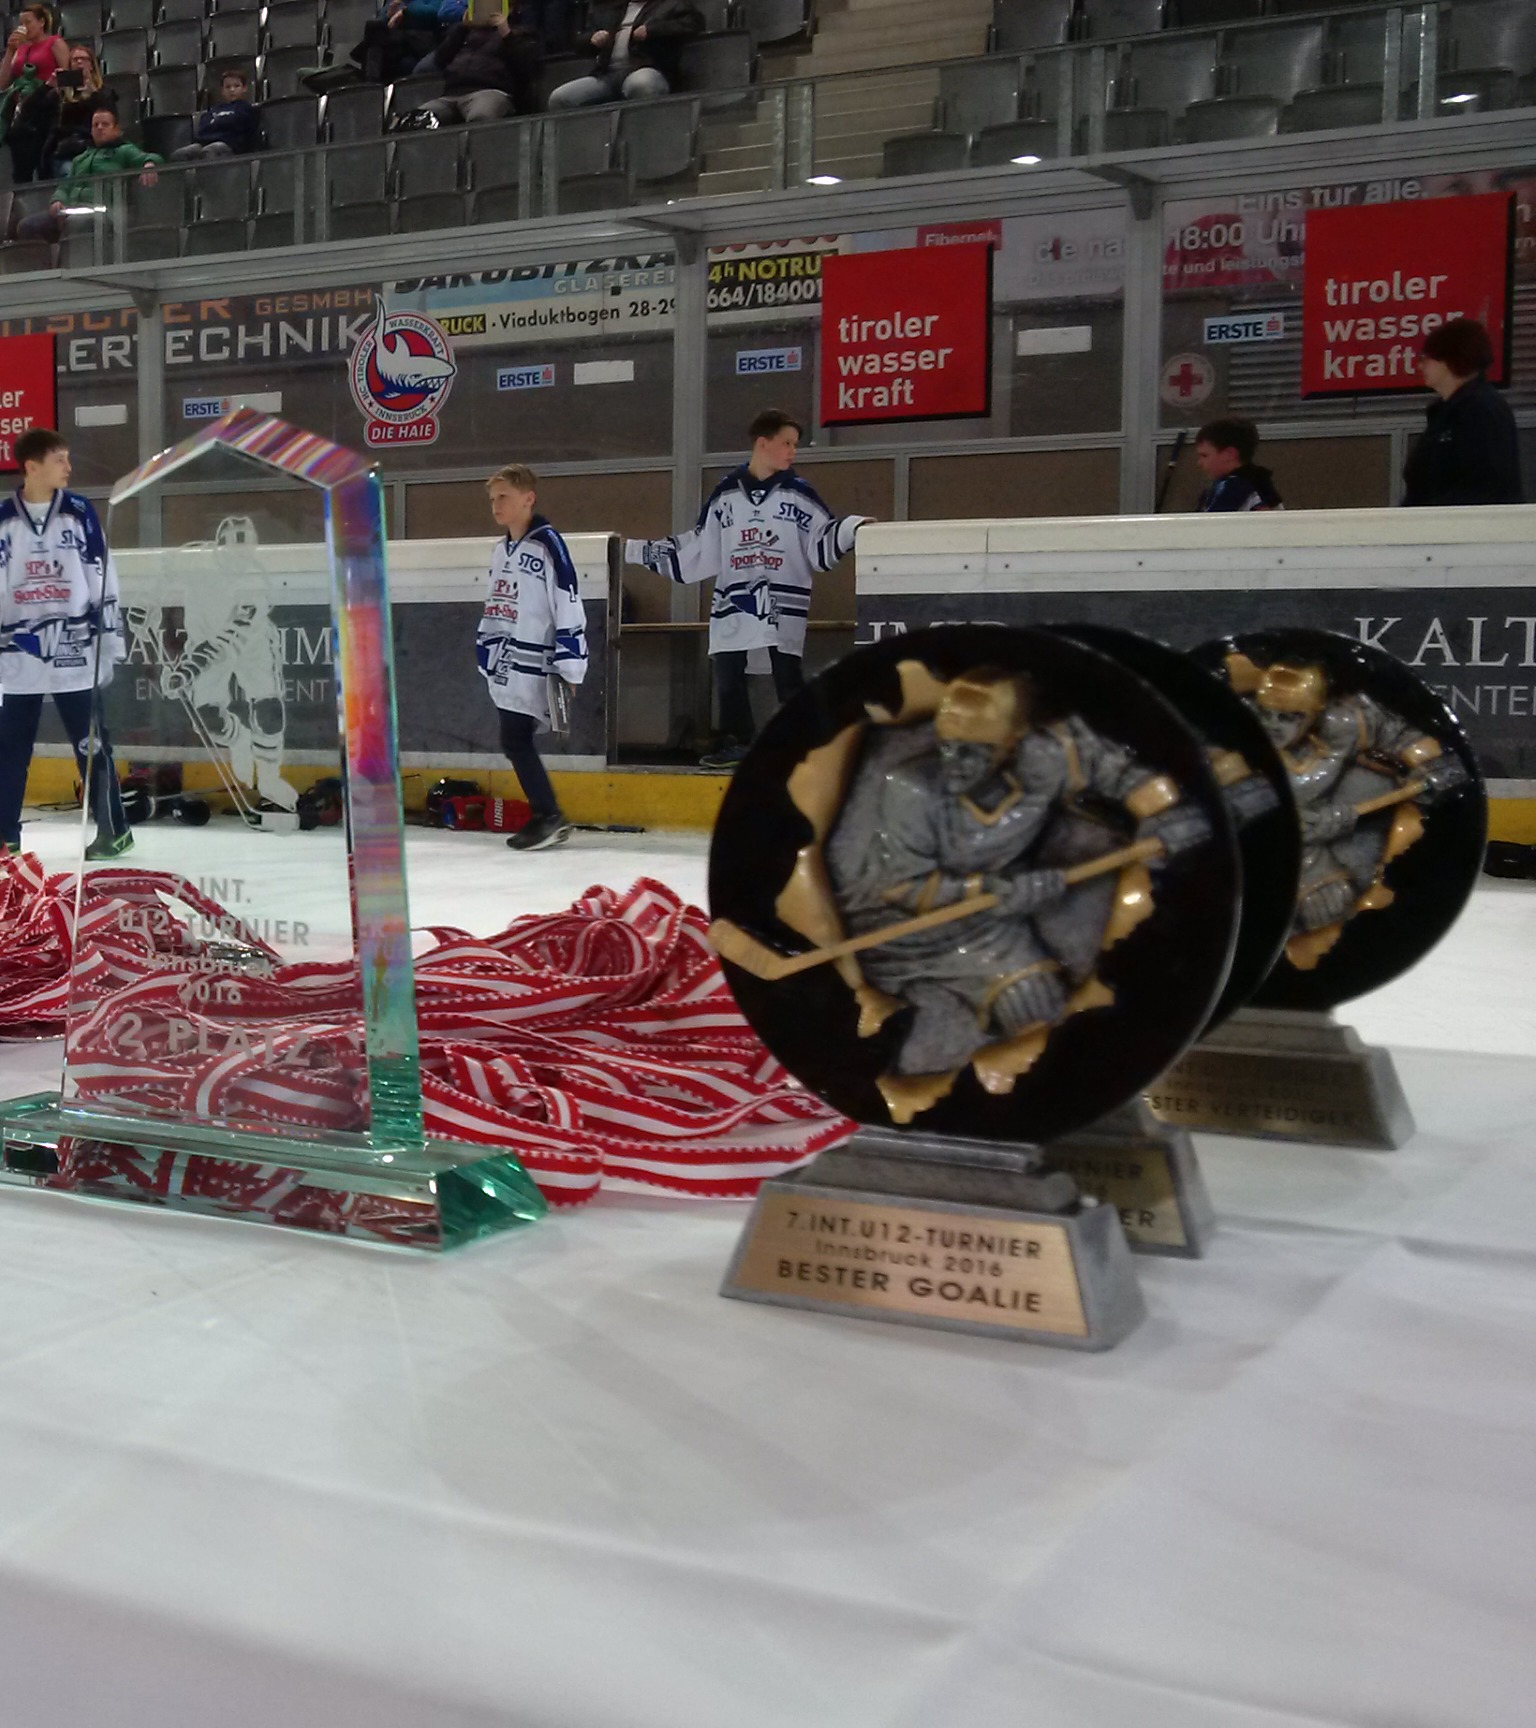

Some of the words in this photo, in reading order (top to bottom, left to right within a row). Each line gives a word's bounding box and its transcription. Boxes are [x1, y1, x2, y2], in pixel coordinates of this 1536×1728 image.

[1169, 222, 1244, 252] 18:00
[255, 287, 373, 317] GESMBH
[1325, 270, 1449, 307] tiroler
[498, 305, 621, 330] Viaduktbogen
[838, 310, 940, 345] tiroler
[1206, 320, 1264, 342] ERSTE
[388, 318, 445, 355] WASSERKRAFT
[737, 353, 785, 374] ERSTE
[837, 346, 954, 377] wasser
[1323, 344, 1416, 381] kraft
[498, 370, 541, 389] ERSTE
[837, 378, 915, 411] kraft
[184, 401, 220, 416] ERSTE
[374, 404, 428, 423] INNSBRUCK
[371, 426, 395, 441] DIE
[398, 423, 433, 439] HAIE
[178, 981, 243, 1004] 2016
[815, 1239, 933, 1270] Innsbruck
[944, 1255, 1004, 1279] 2016
[777, 1259, 890, 1293] BESTER
[908, 1276, 1043, 1313] GOALIE
